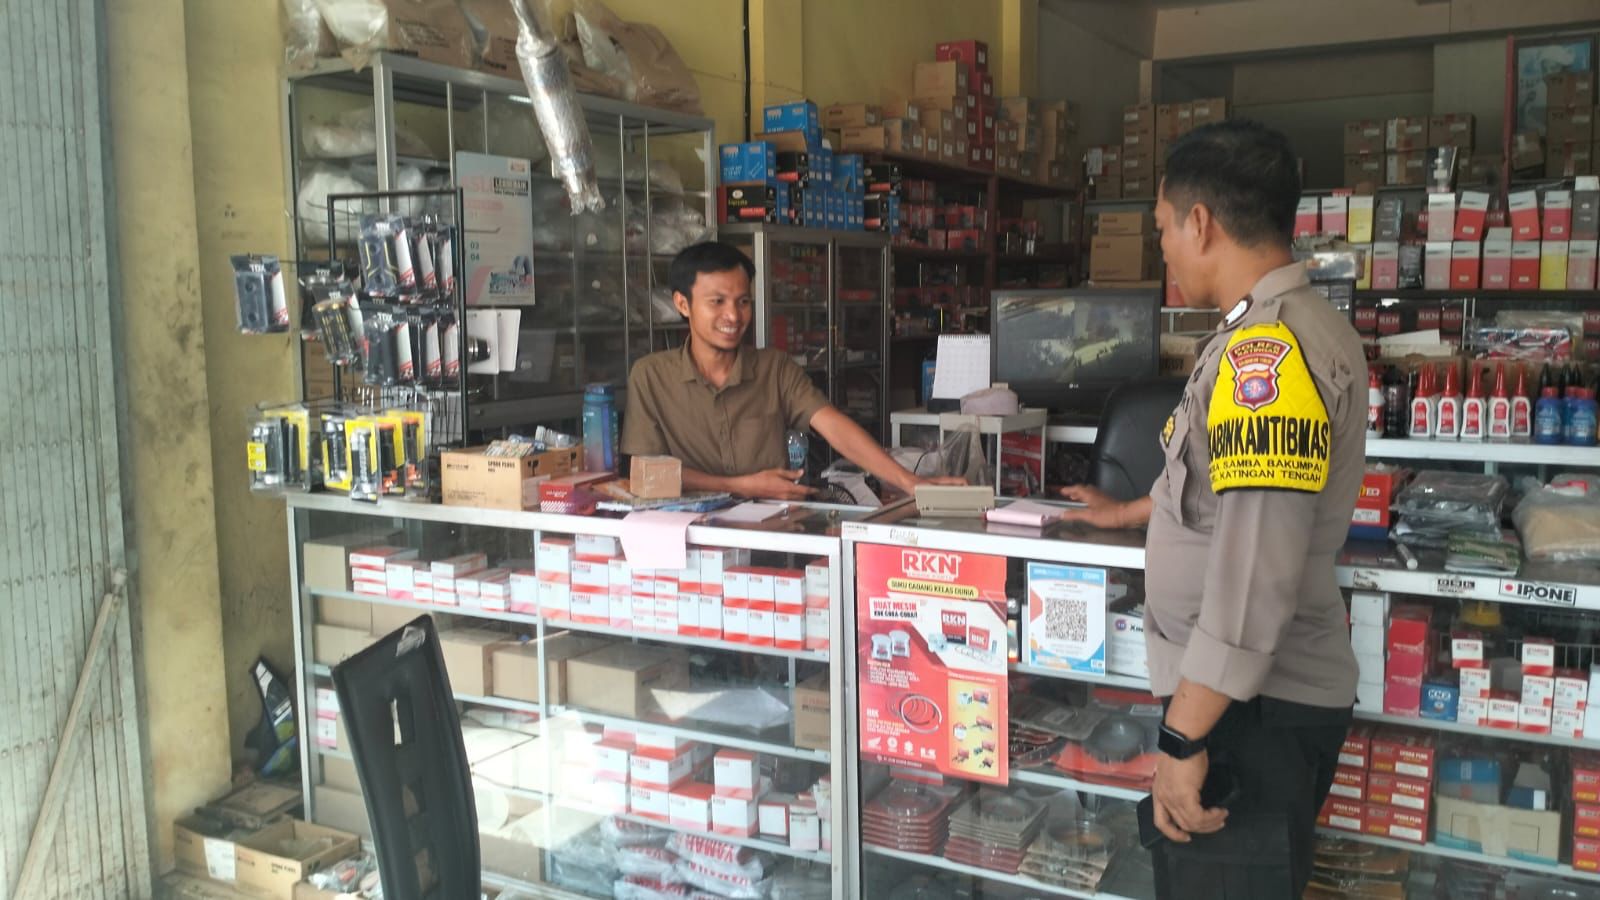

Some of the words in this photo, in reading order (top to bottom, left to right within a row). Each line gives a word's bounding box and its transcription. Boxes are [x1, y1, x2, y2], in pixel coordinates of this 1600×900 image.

[1222, 459, 1261, 469] SAMBA
[1267, 458, 1323, 473] BAKUMPAI
[1220, 470, 1275, 480] KATINGAN
[1280, 470, 1321, 484] TENGAH
[901, 550, 959, 578] RKN
[934, 585, 955, 595] KELAS
[1517, 583, 1573, 601] IPONE
[942, 613, 966, 625] RKN
